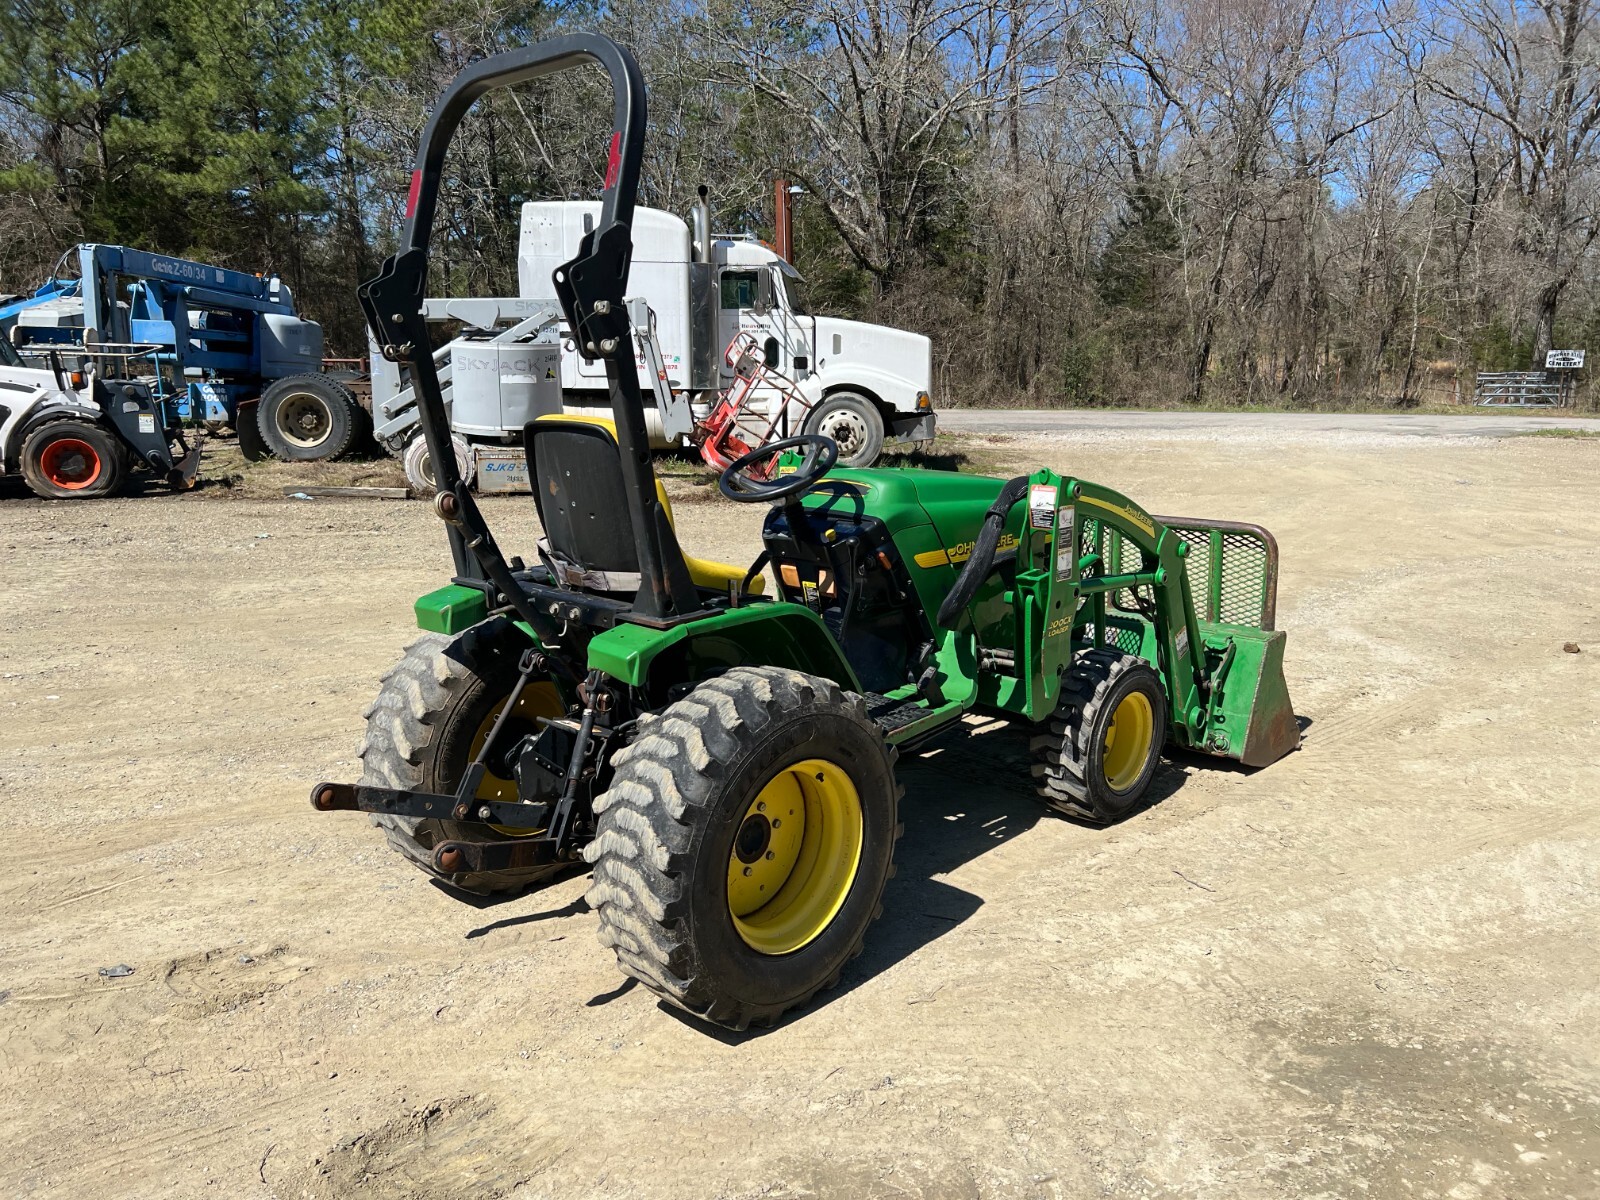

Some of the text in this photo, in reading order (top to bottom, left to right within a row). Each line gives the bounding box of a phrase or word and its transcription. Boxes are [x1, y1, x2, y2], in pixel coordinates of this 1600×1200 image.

[151, 258, 206, 281] Genie Z-60/34
[457, 355, 541, 373] SKYJACK
[202, 385, 226, 394] Genie
[200, 393, 228, 402] BOOM
[1048, 625, 1069, 638] LOADER
